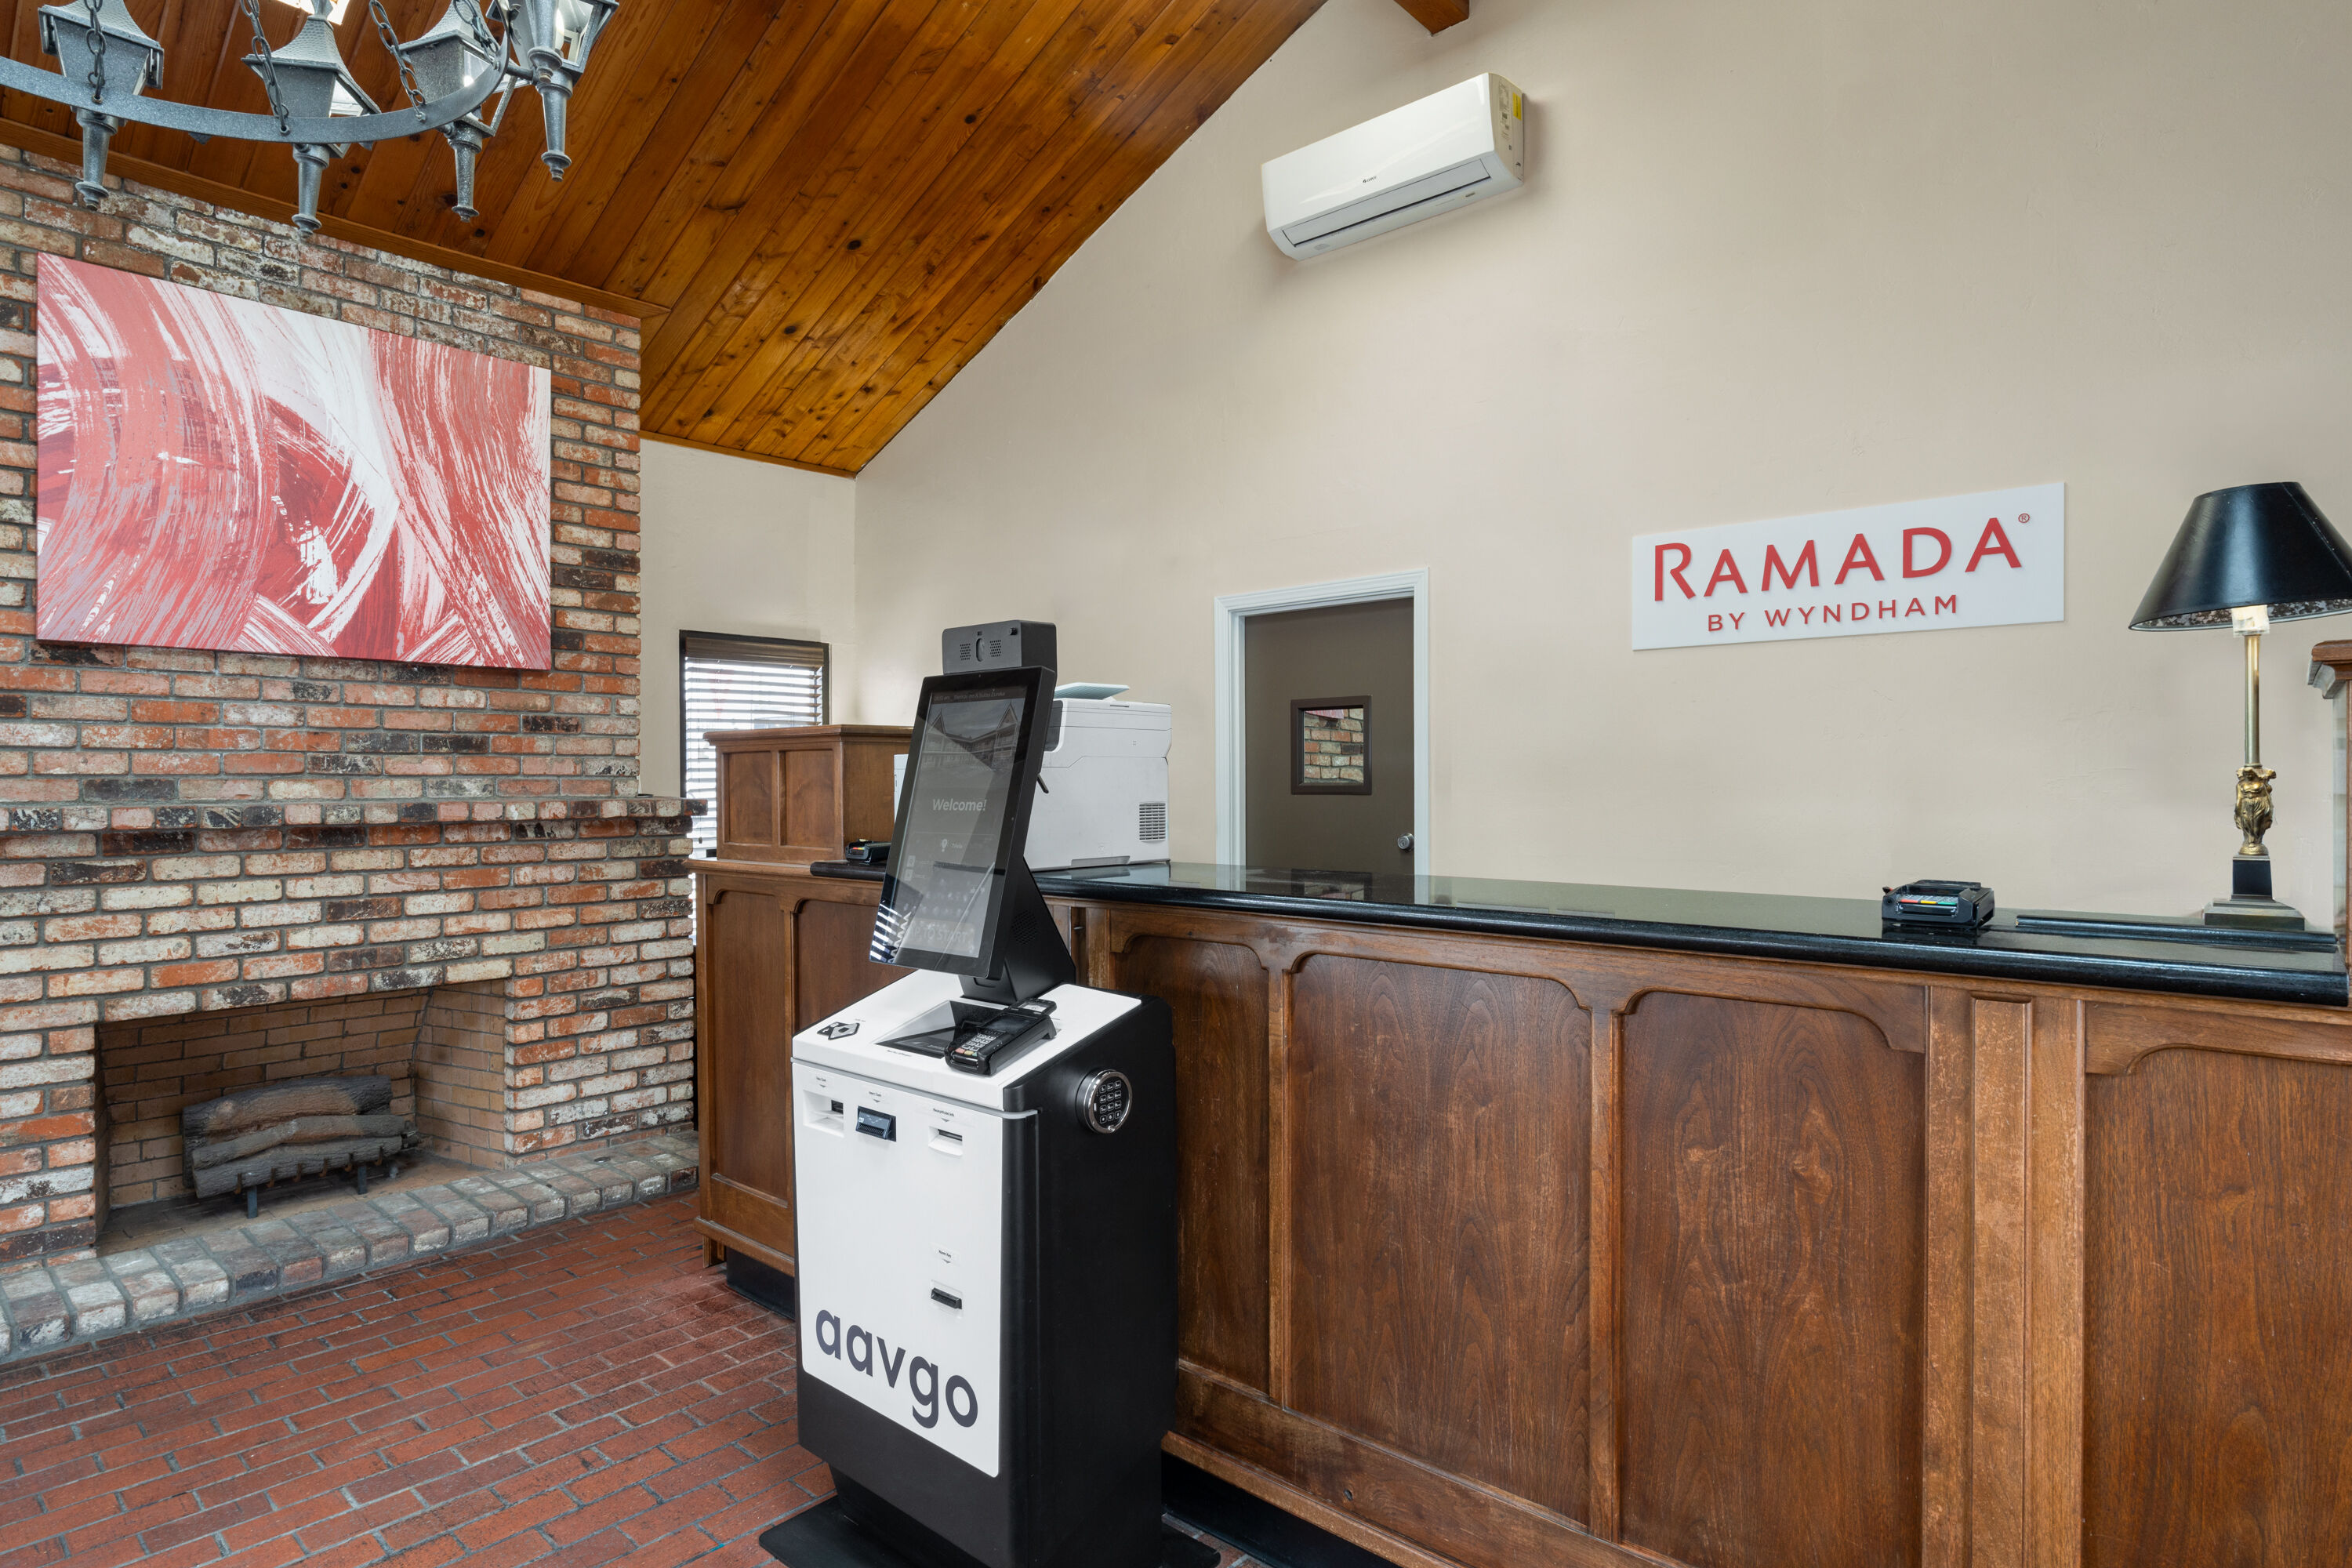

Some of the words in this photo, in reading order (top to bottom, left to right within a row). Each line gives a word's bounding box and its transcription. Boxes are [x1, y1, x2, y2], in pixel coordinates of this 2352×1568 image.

[1654, 517, 2022, 602] RAMADA
[1708, 612, 1744, 632] BY
[1764, 594, 1957, 628] WYNDHAM
[932, 798, 987, 811] Welcome!
[815, 1309, 978, 1429] aavgo
